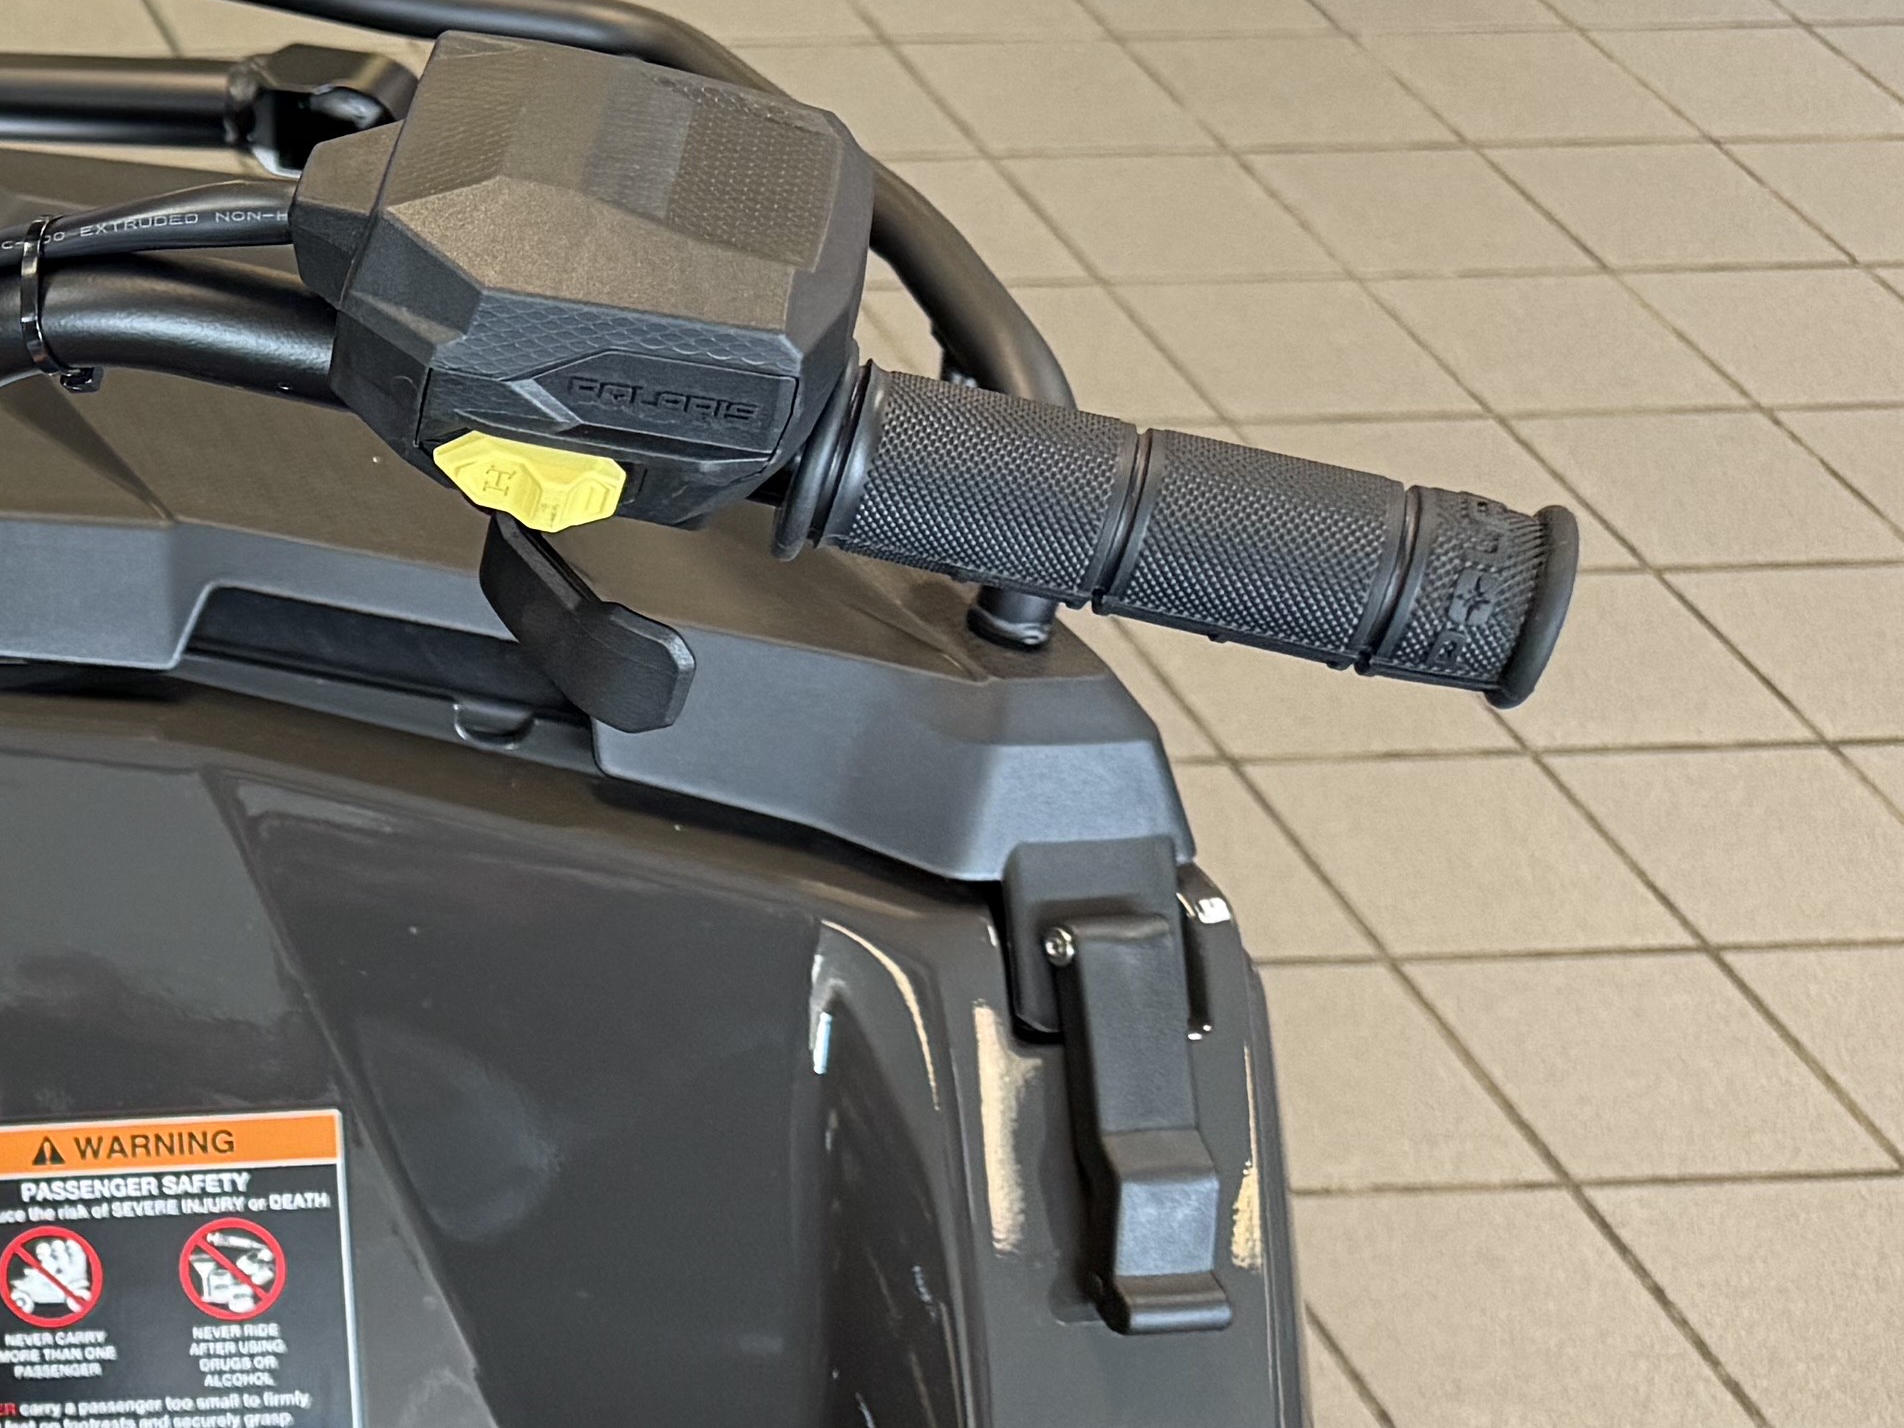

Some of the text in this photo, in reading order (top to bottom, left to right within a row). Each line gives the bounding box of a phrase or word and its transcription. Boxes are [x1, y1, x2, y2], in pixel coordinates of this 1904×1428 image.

[567, 375, 760, 421] POLARIS
[73, 1129, 234, 1160] WARNING
[20, 1171, 249, 1202] PASSENGER SAFETY
